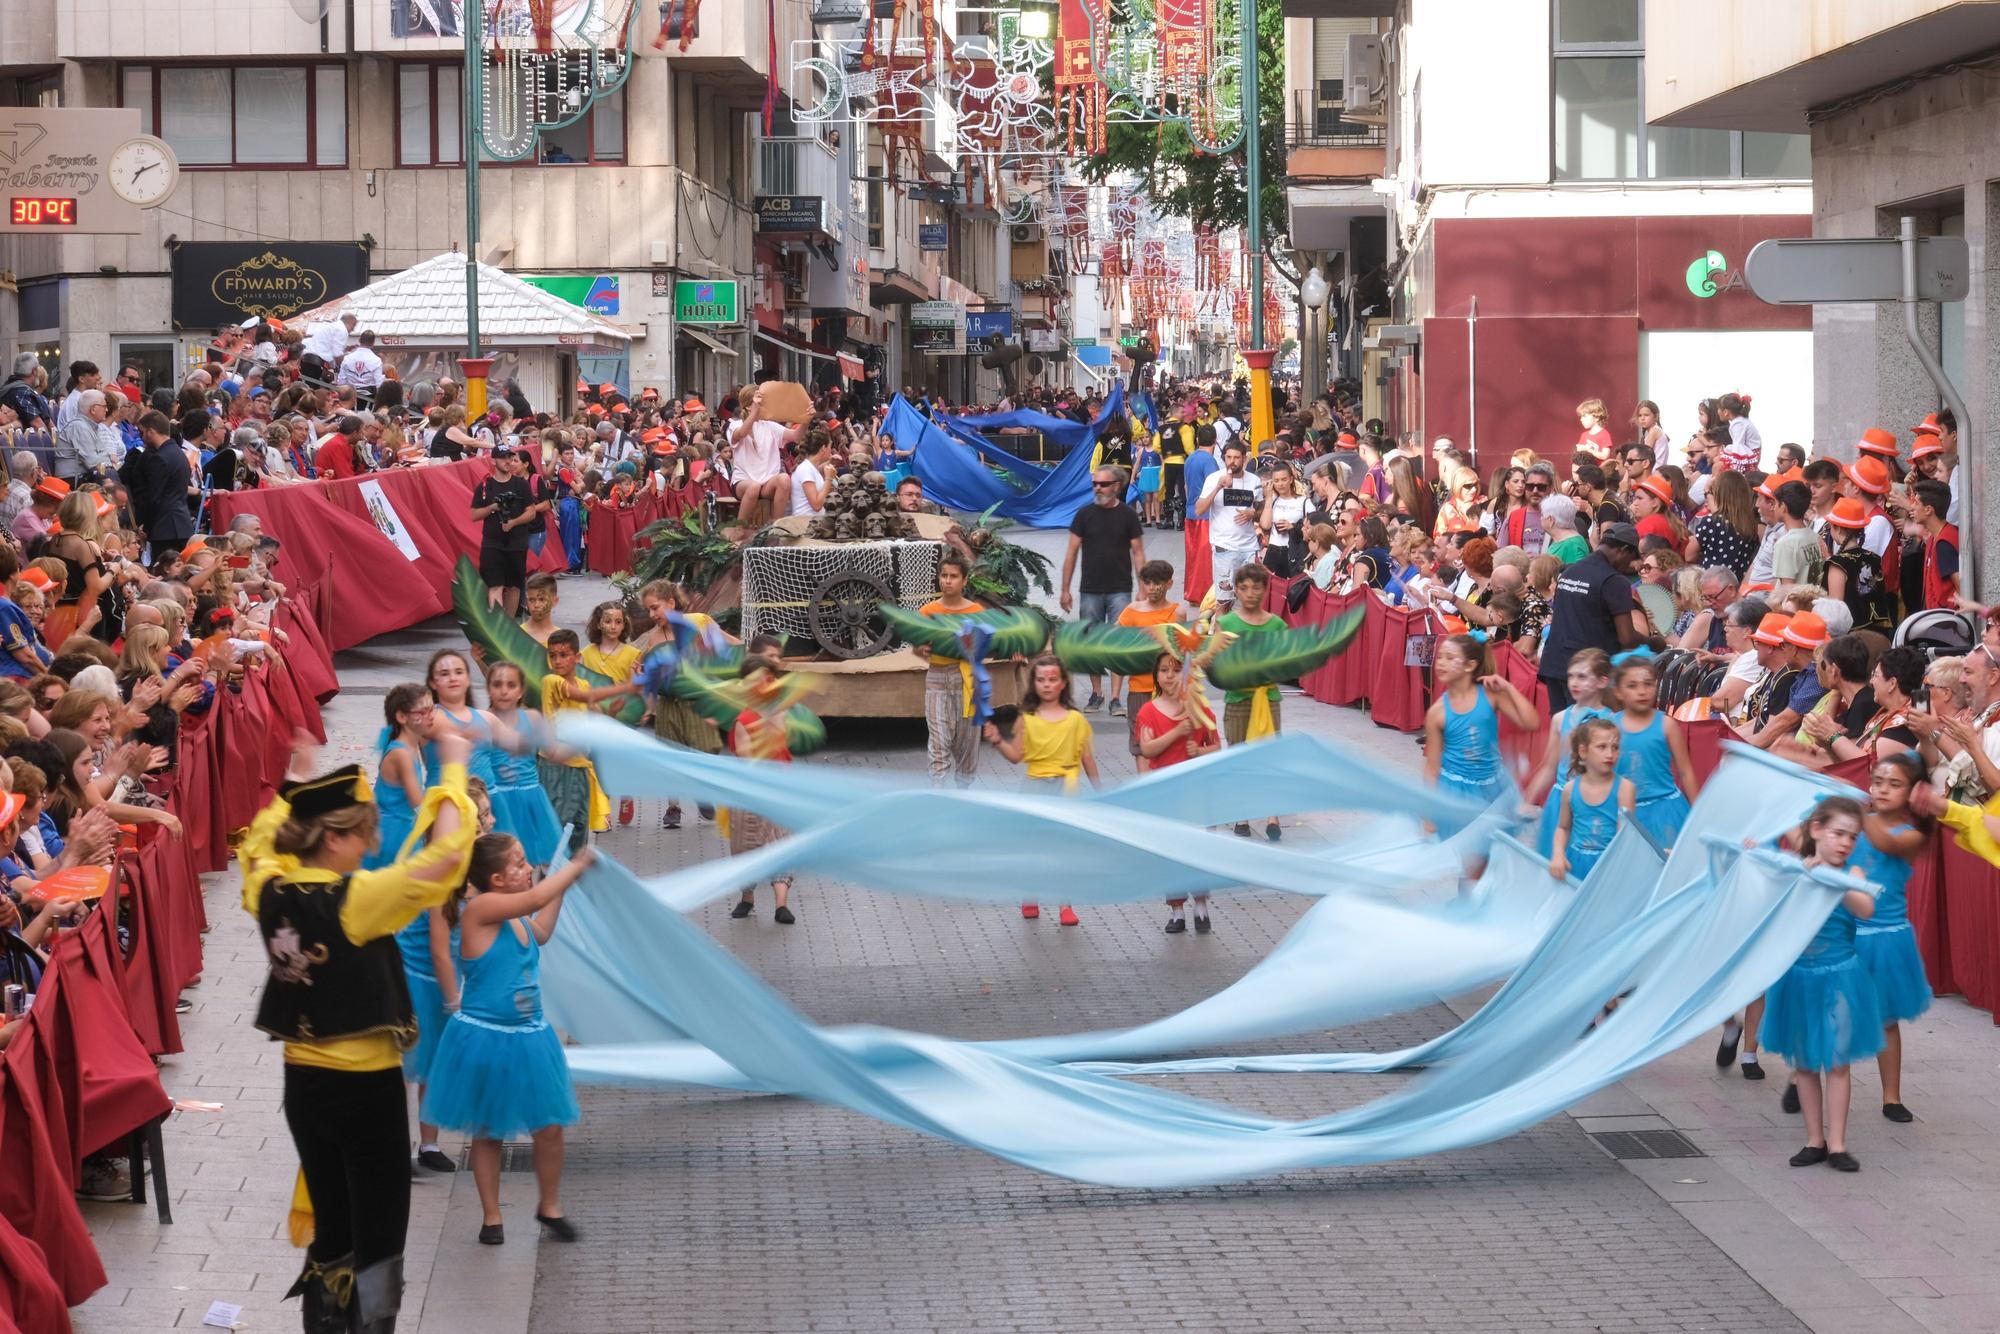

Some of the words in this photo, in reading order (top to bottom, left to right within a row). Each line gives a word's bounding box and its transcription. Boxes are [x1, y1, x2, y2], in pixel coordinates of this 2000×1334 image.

[45, 154, 98, 169] Joyería
[761, 199, 791, 211] ACB
[225, 278, 313, 290] EDWARD'S
[682, 304, 727, 318] HOFU
